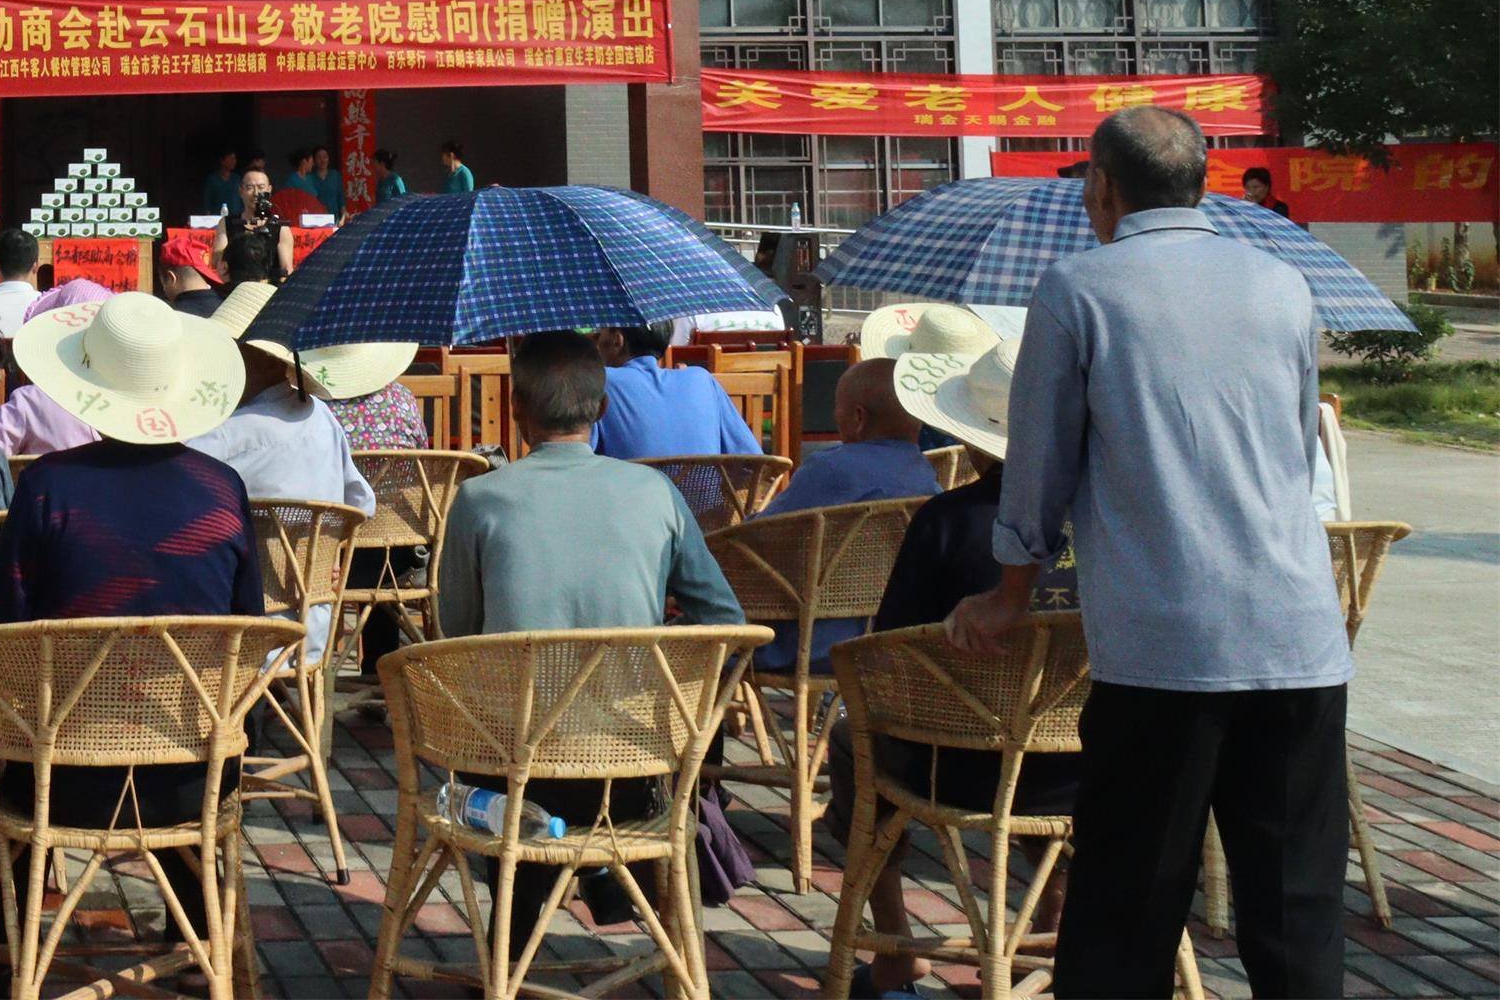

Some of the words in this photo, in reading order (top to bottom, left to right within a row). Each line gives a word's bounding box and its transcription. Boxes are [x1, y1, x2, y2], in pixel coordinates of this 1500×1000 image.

[716, 80, 1249, 112] 关爱老人健康
